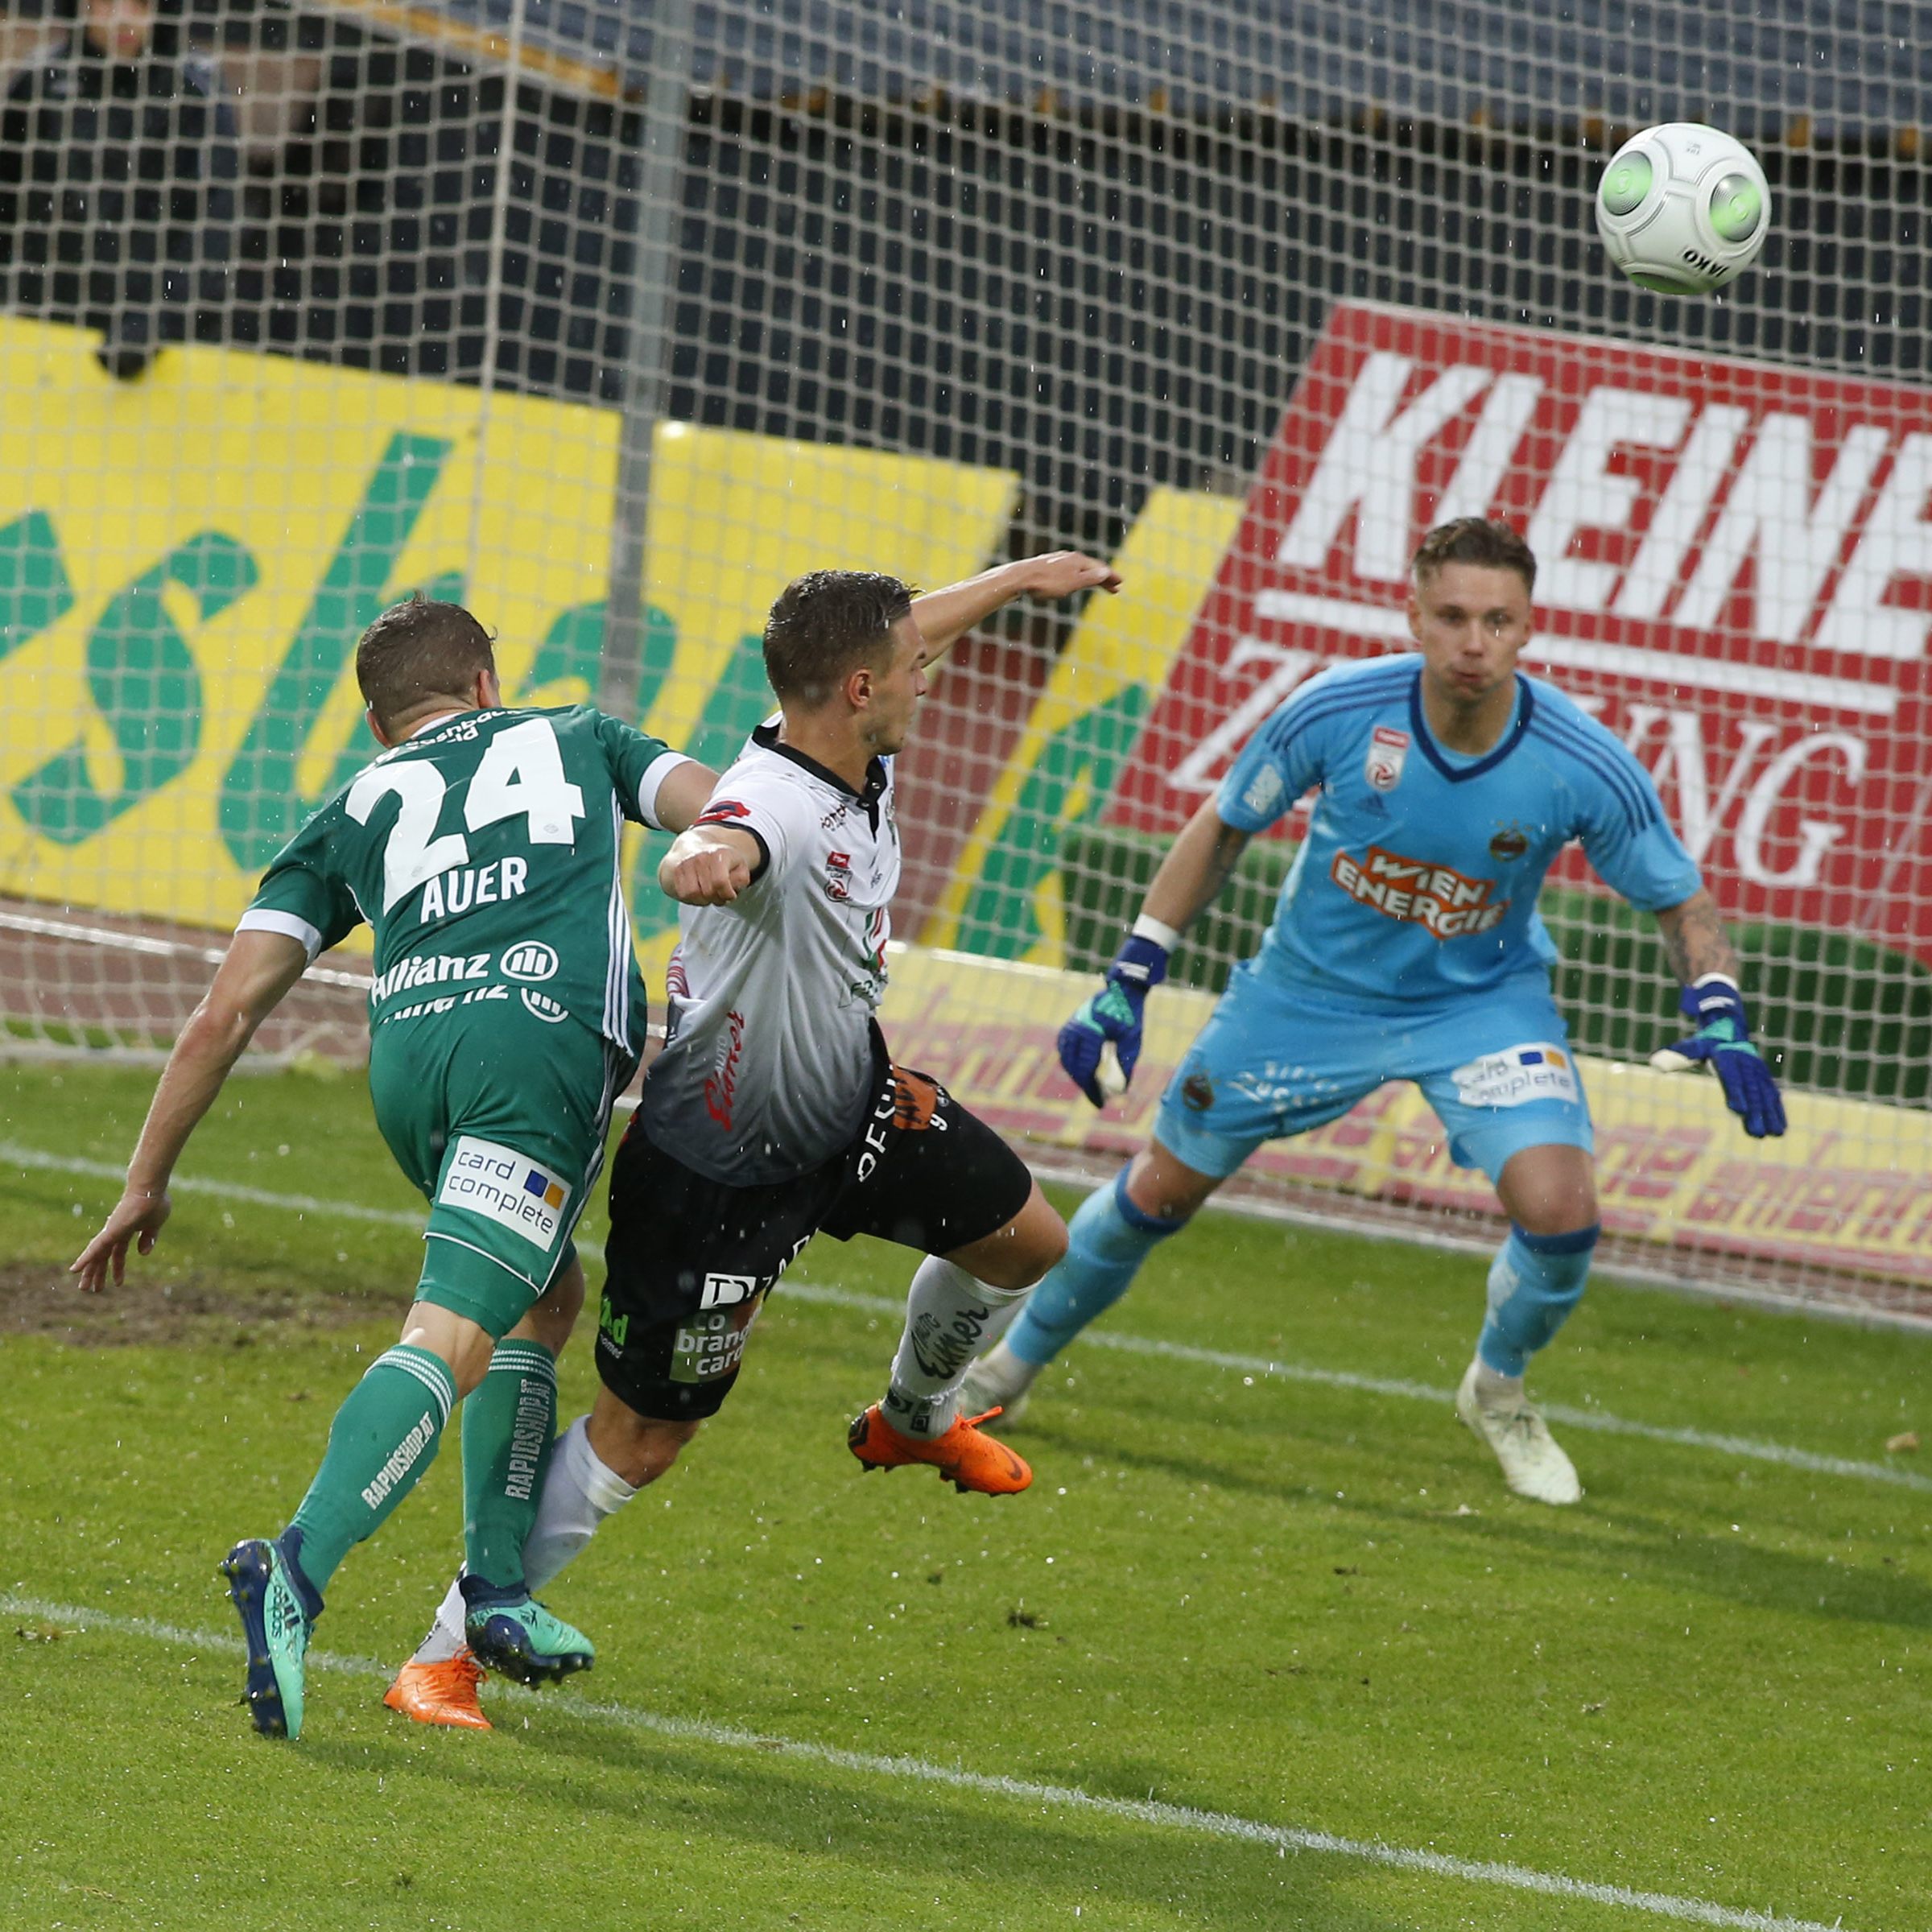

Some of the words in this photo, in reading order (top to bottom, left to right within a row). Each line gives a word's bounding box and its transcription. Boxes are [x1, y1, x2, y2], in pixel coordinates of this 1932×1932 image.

[345, 717, 586, 917] 24
[420, 857, 528, 924] AUER
[371, 952, 491, 1007] Allianz
[458, 1151, 516, 1180] card
[448, 1175, 554, 1235] complete
